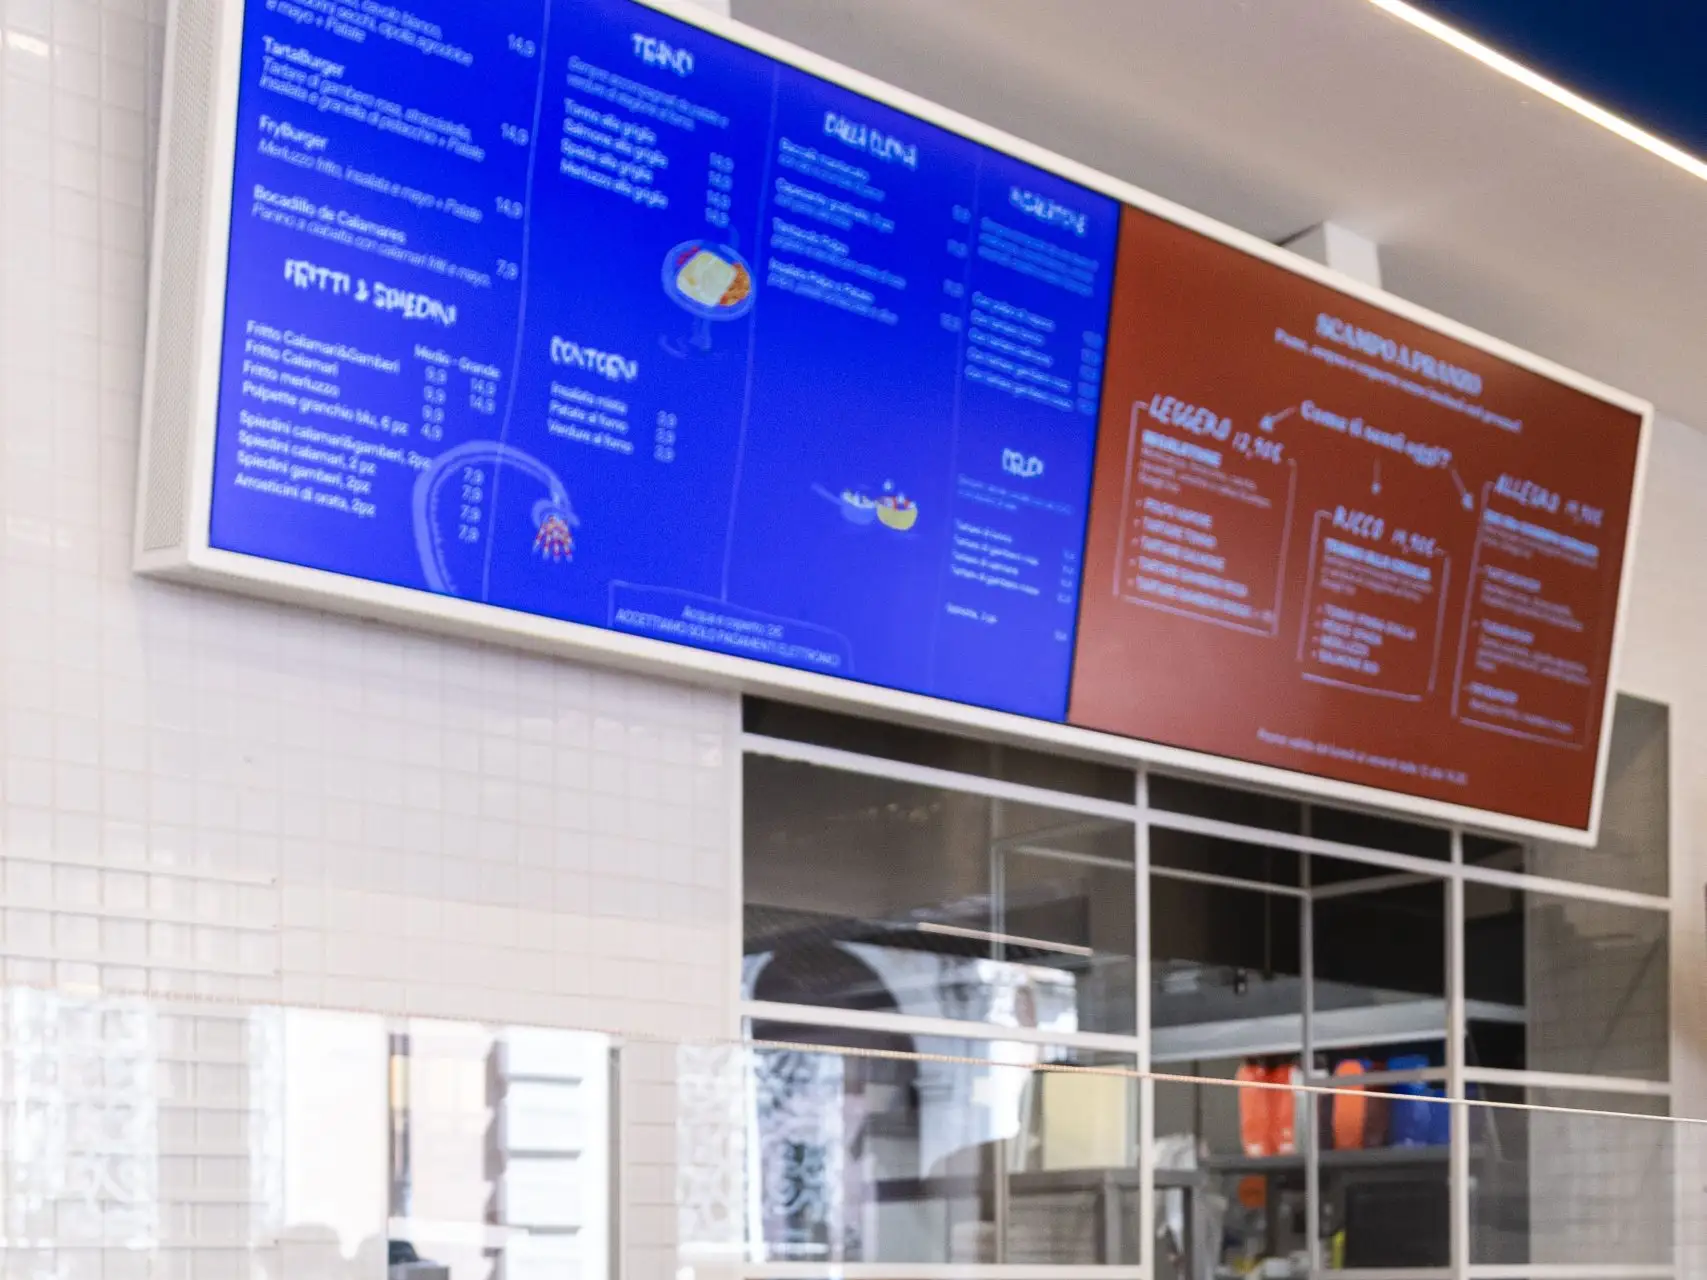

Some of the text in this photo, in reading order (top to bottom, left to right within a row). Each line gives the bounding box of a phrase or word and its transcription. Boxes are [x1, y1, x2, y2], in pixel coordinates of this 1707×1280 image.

[325, 16, 366, 42] Patate
[262, 36, 344, 77] TartaBurger
[508, 34, 535, 57] 14,9
[263, 56, 307, 86] Tartare
[259, 114, 328, 150] FryBurger
[501, 123, 529, 145] 14,9
[258, 138, 315, 168] Merluzzo
[253, 184, 317, 217] Bocadillo
[335, 210, 406, 246] Calamares
[284, 259, 350, 294] FRITTI
[373, 282, 456, 326] SPIEDINI
[246, 320, 283, 342] Fritto
[245, 339, 338, 376] Fritto Calamari
[458, 357, 500, 380] Grande
[243, 360, 340, 397] Fritto merluzzo
[242, 380, 299, 406] Polpette
[297, 397, 356, 421] granchio
[240, 409, 291, 434] Spiedini
[1147, 394, 1231, 440] LEGGERO
[1300, 400, 1350, 432] Come
[238, 429, 290, 454] Spiedini
[237, 450, 289, 474] Spiedini
